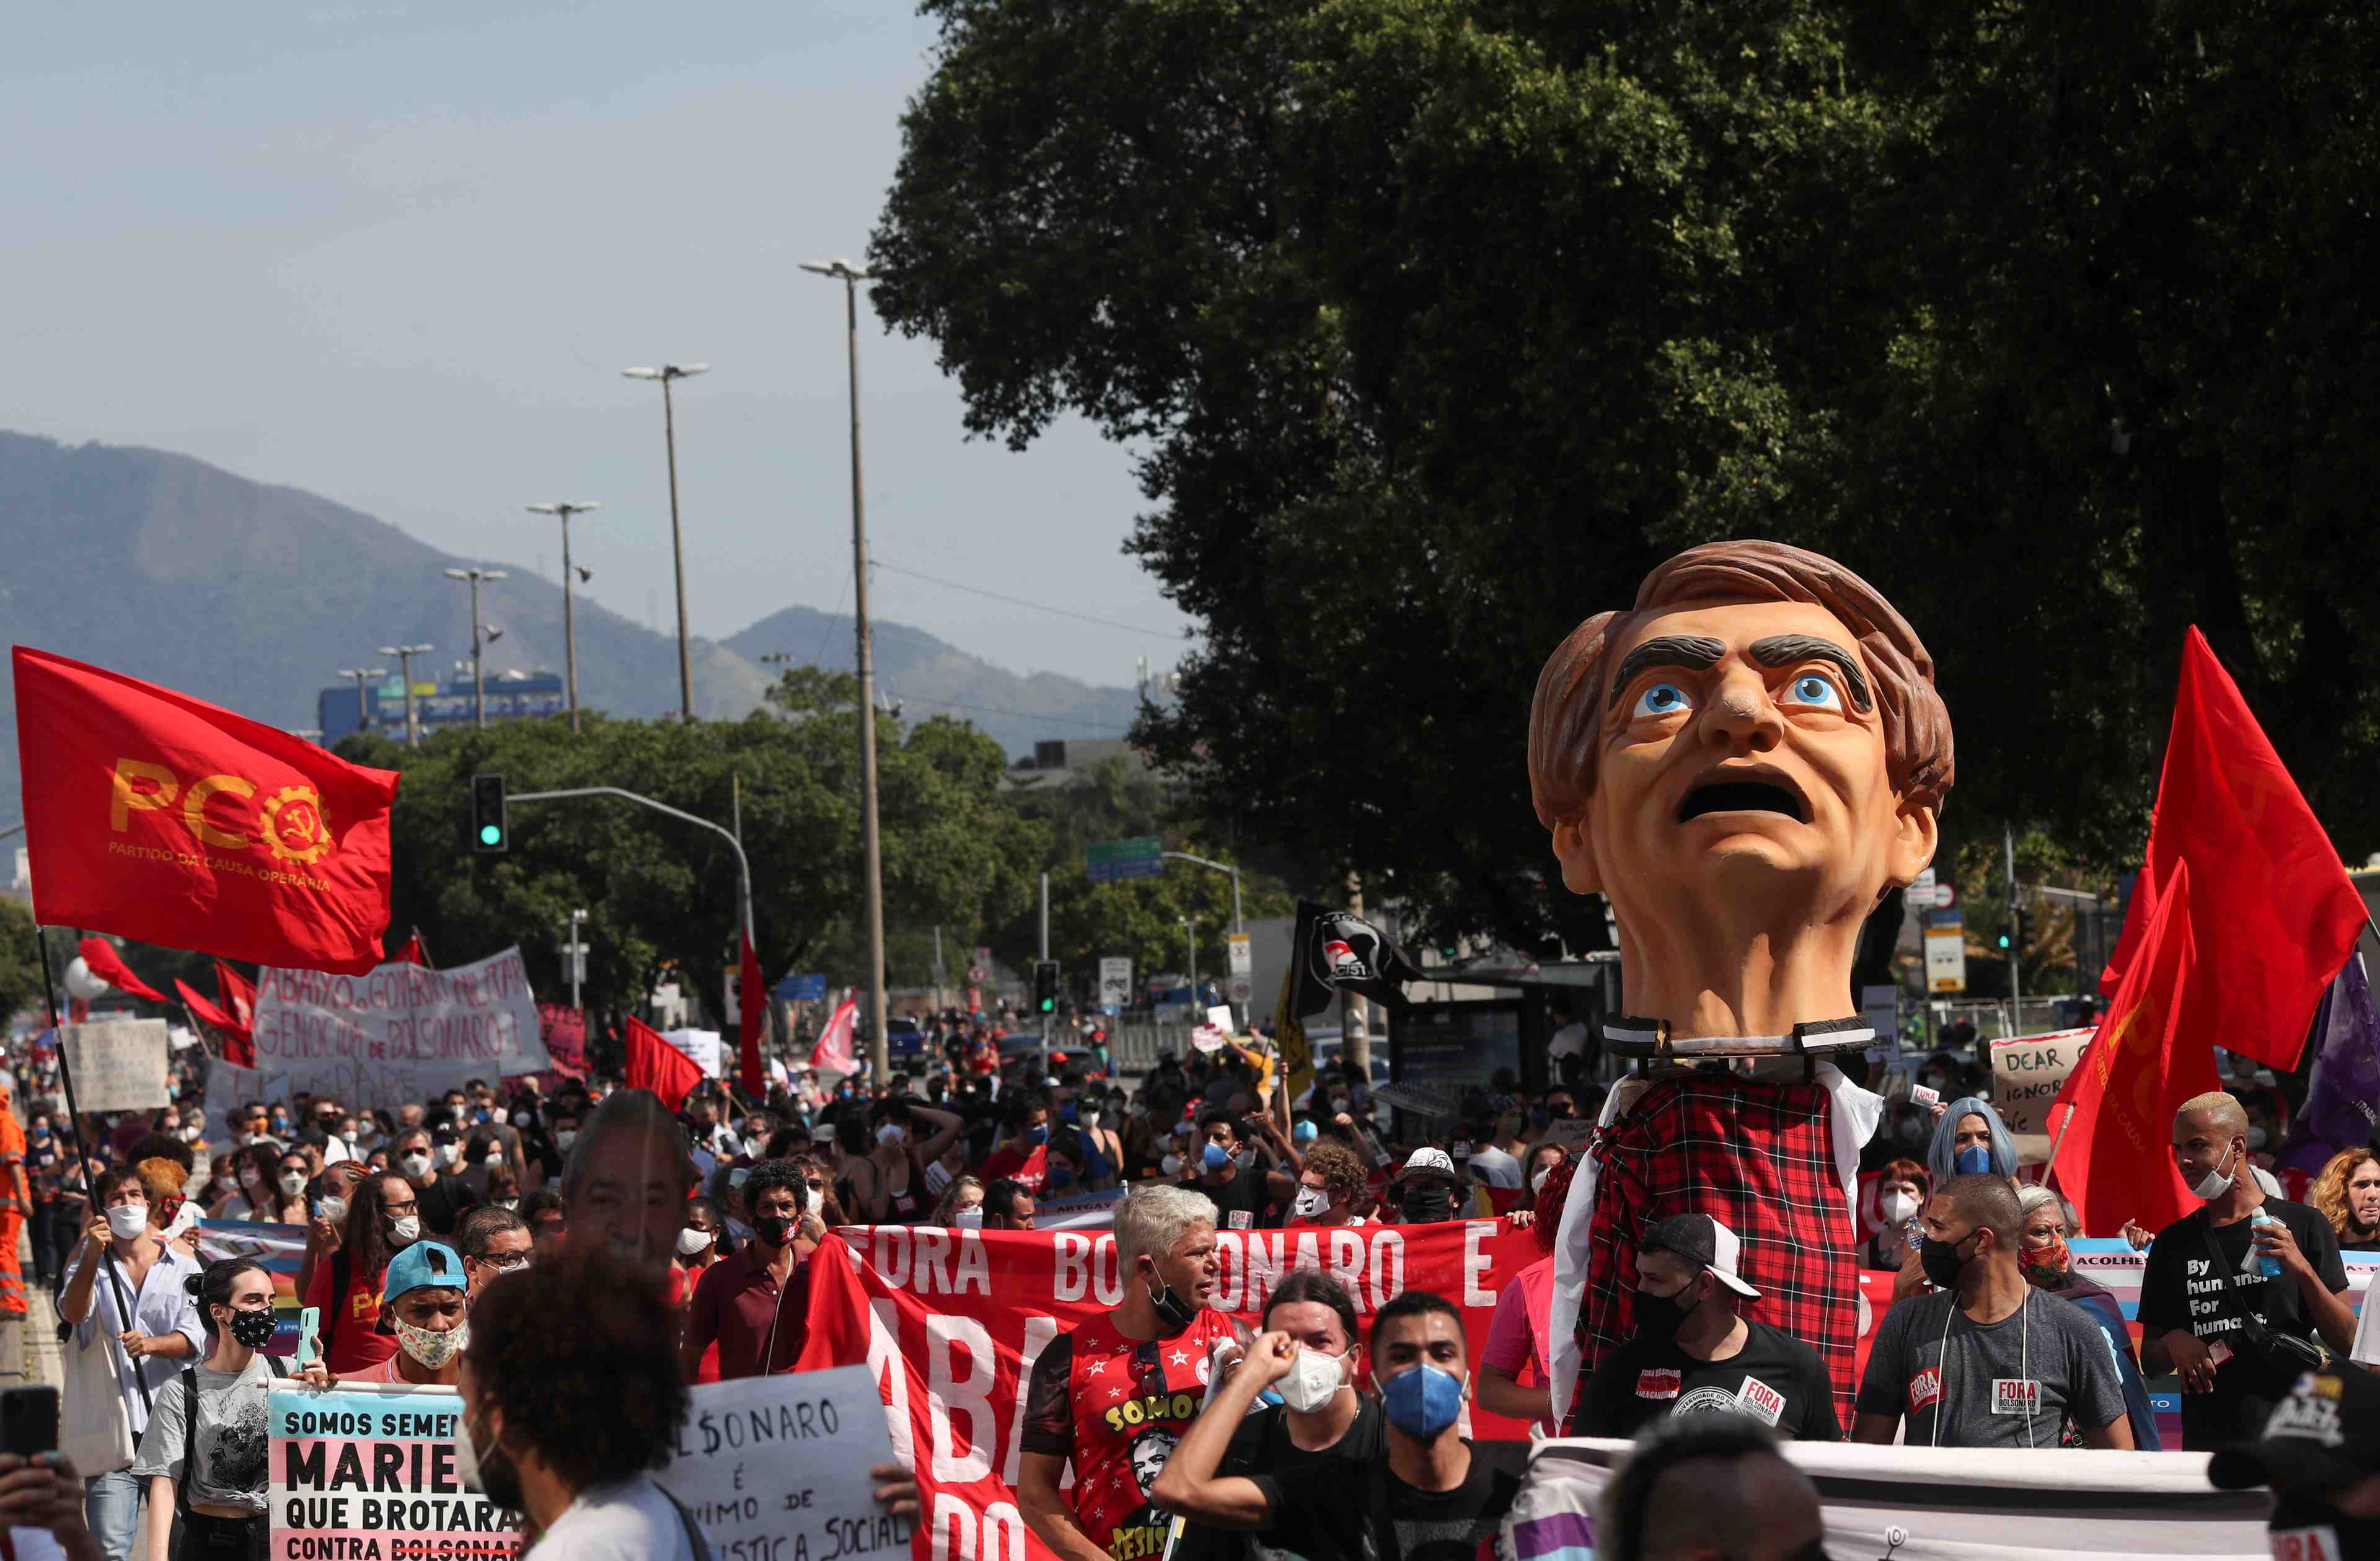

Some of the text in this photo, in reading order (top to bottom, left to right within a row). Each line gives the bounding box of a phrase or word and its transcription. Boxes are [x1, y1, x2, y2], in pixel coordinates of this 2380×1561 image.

[109, 842, 174, 862] PARTIDO
[178, 853, 200, 867] DA
[204, 857, 254, 877] CAUSA
[2006, 1048, 2065, 1071] DEAR
[1056, 1201, 1112, 1213] ARTGAY
[1231, 1211, 1250, 1221] FORA
[1053, 1230, 1404, 1314] BOONARO
[1464, 1221, 1499, 1307] E
[2187, 1259, 2210, 1276] By
[2190, 1299, 2219, 1316] For
[1746, 1380, 1780, 1413] FORA
[1910, 1371, 1939, 1399] FORA
[1999, 1381, 2037, 1399] FORA
[1743, 1395, 1775, 1420] BOLSONARO
[1998, 1399, 2036, 1407] BOLSONARO
[284, 1412, 372, 1436] SOMOS
[734, 1462, 744, 1490] É
[783, 1488, 814, 1511] DE
[286, 1498, 349, 1529] QUE
[286, 1537, 382, 1561] CONTRA
